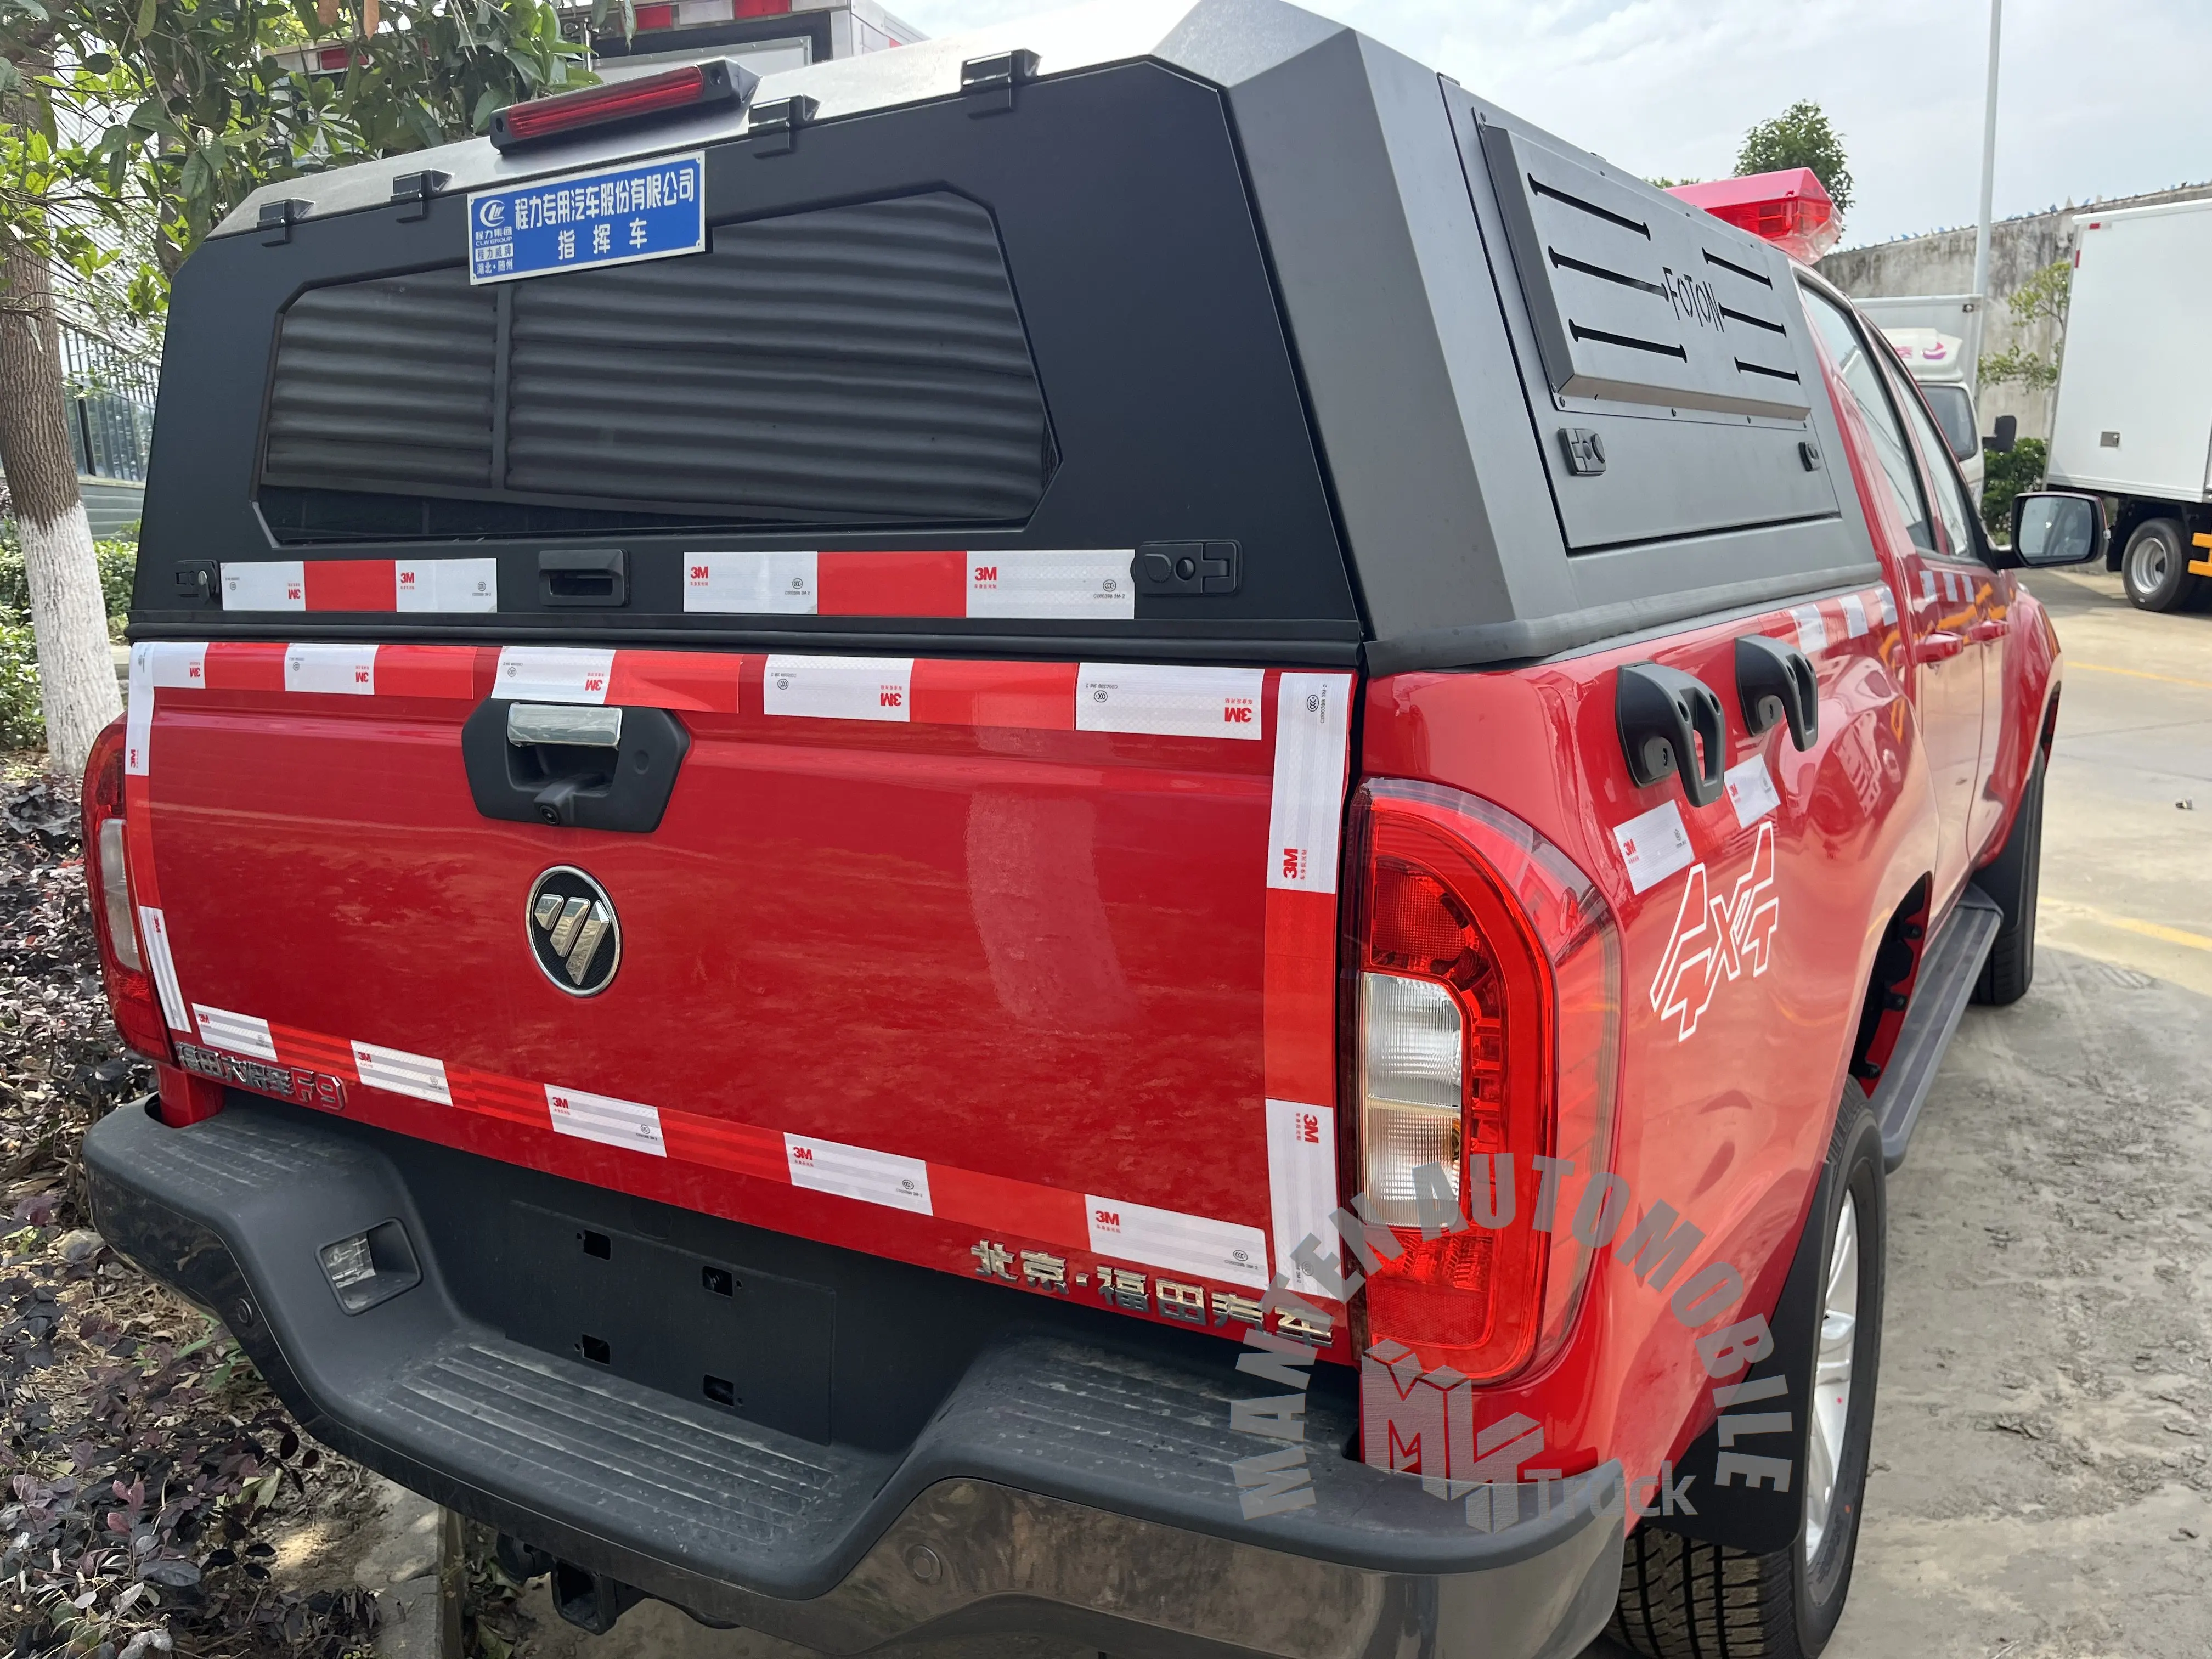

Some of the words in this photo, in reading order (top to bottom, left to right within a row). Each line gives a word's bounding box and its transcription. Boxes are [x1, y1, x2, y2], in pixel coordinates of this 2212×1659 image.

[515, 168, 695, 230] 程力专用汽车股份有限公司
[1662, 266, 1724, 333] FOTON
[400, 572, 414, 583] 3M
[690, 566, 708, 579] 3M
[974, 567, 997, 581] 3M
[288, 589, 301, 600] 3M
[356, 672, 369, 683] 3M
[584, 679, 603, 691] 3M
[880, 693, 901, 707] 3M
[1224, 707, 1252, 723] 3M
[1623, 838, 1637, 856] 3M
[1283, 848, 1299, 879] 3M
[358, 1052, 372, 1063] 3M
[552, 1097, 569, 1109] 3M
[1303, 1113, 1319, 1144] 3M
[793, 1147, 812, 1160] 3M
[1095, 1210, 1120, 1226] 3M
